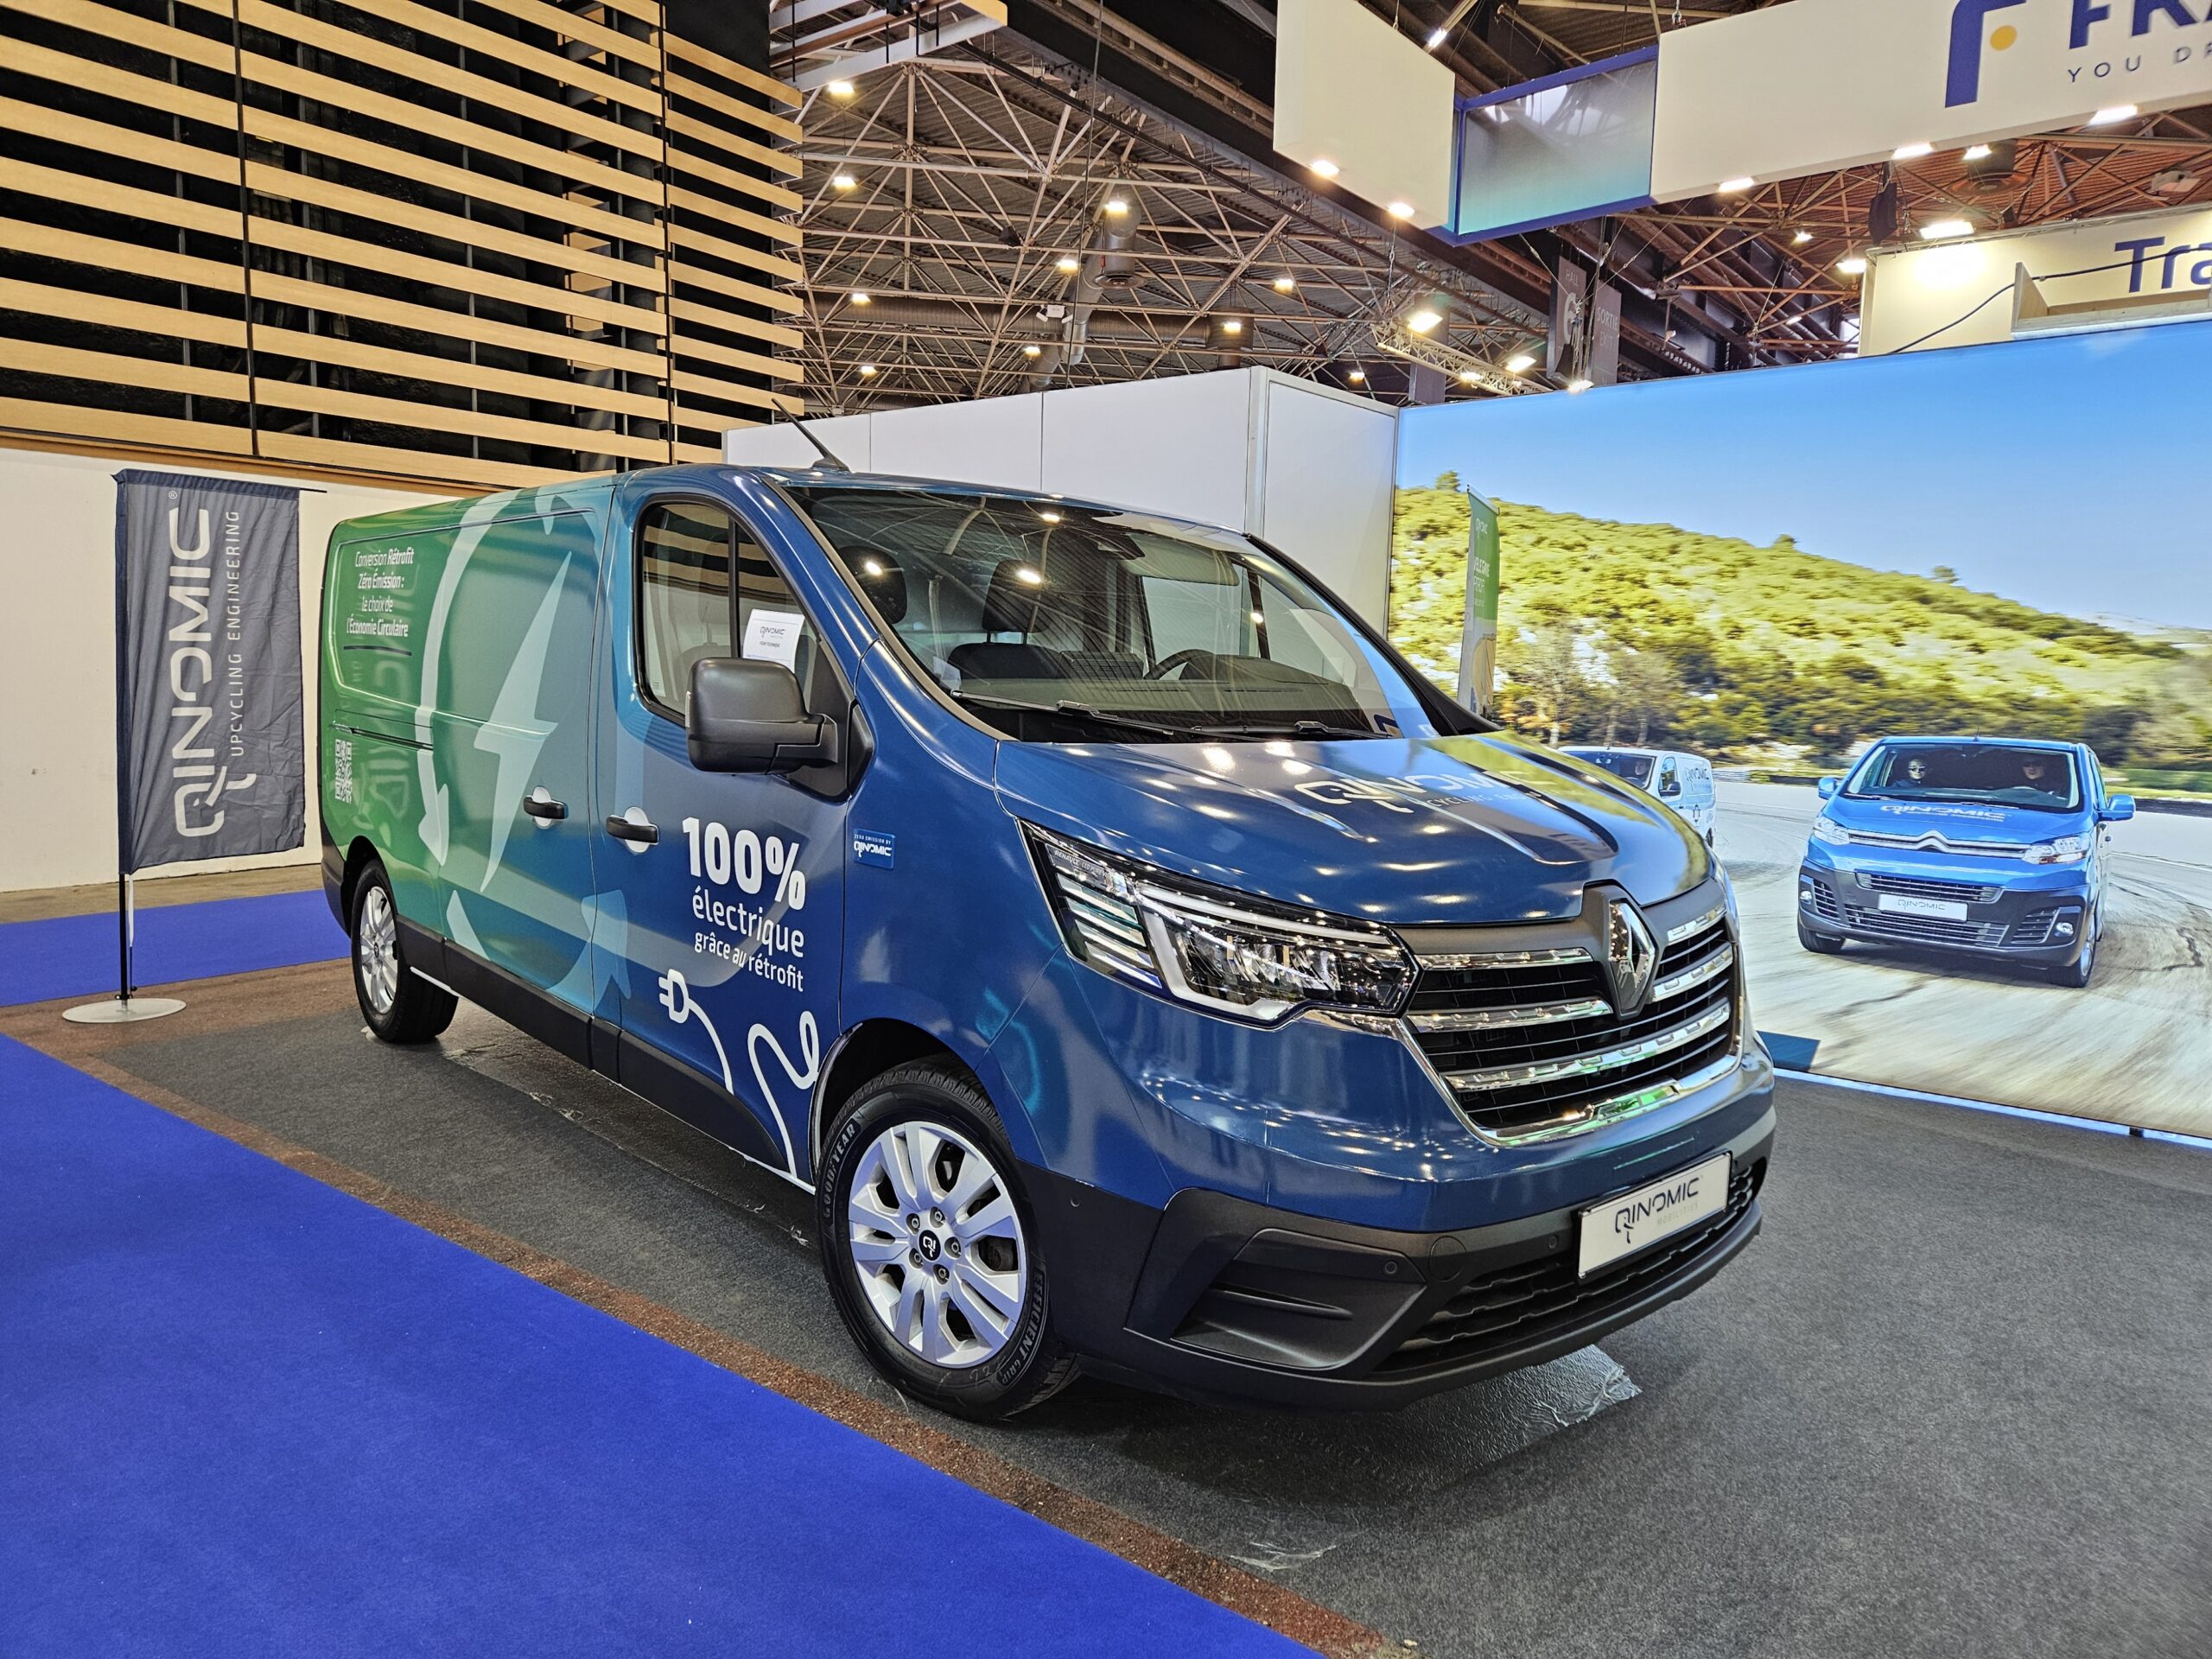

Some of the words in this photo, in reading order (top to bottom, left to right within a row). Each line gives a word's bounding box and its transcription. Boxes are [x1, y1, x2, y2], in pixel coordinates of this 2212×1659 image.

[2068, 55, 2141, 83] YOU
[1565, 268, 1580, 288] HALL
[1598, 307, 1618, 332] SORTIE
[1599, 331, 1613, 347] EXIT
[355, 550, 387, 567] Conversion
[387, 547, 415, 565] Rétrofit
[226, 511, 240, 641] ENGINEERING
[358, 572, 372, 589] Zéro
[372, 568, 401, 588] Émission
[368, 595, 385, 612] choix
[385, 594, 393, 612] de
[377, 618, 409, 637] Circulaire
[168, 506, 257, 837] QINOMIC
[228, 653, 244, 757] UPCYCLING
[854, 840, 893, 858] QINOMIC
[1054, 849, 1079, 865] RENAULT
[682, 817, 806, 911] 100%
[692, 885, 805, 958] électrique
[694, 931, 730, 960] grâce
[732, 947, 747, 969] au
[748, 952, 804, 993] rétrofit
[1615, 1177, 1700, 1244] QINOMIC
[1019, 1271, 1044, 1361] EFFICIENT
[1001, 1358, 1022, 1383] GRIP
